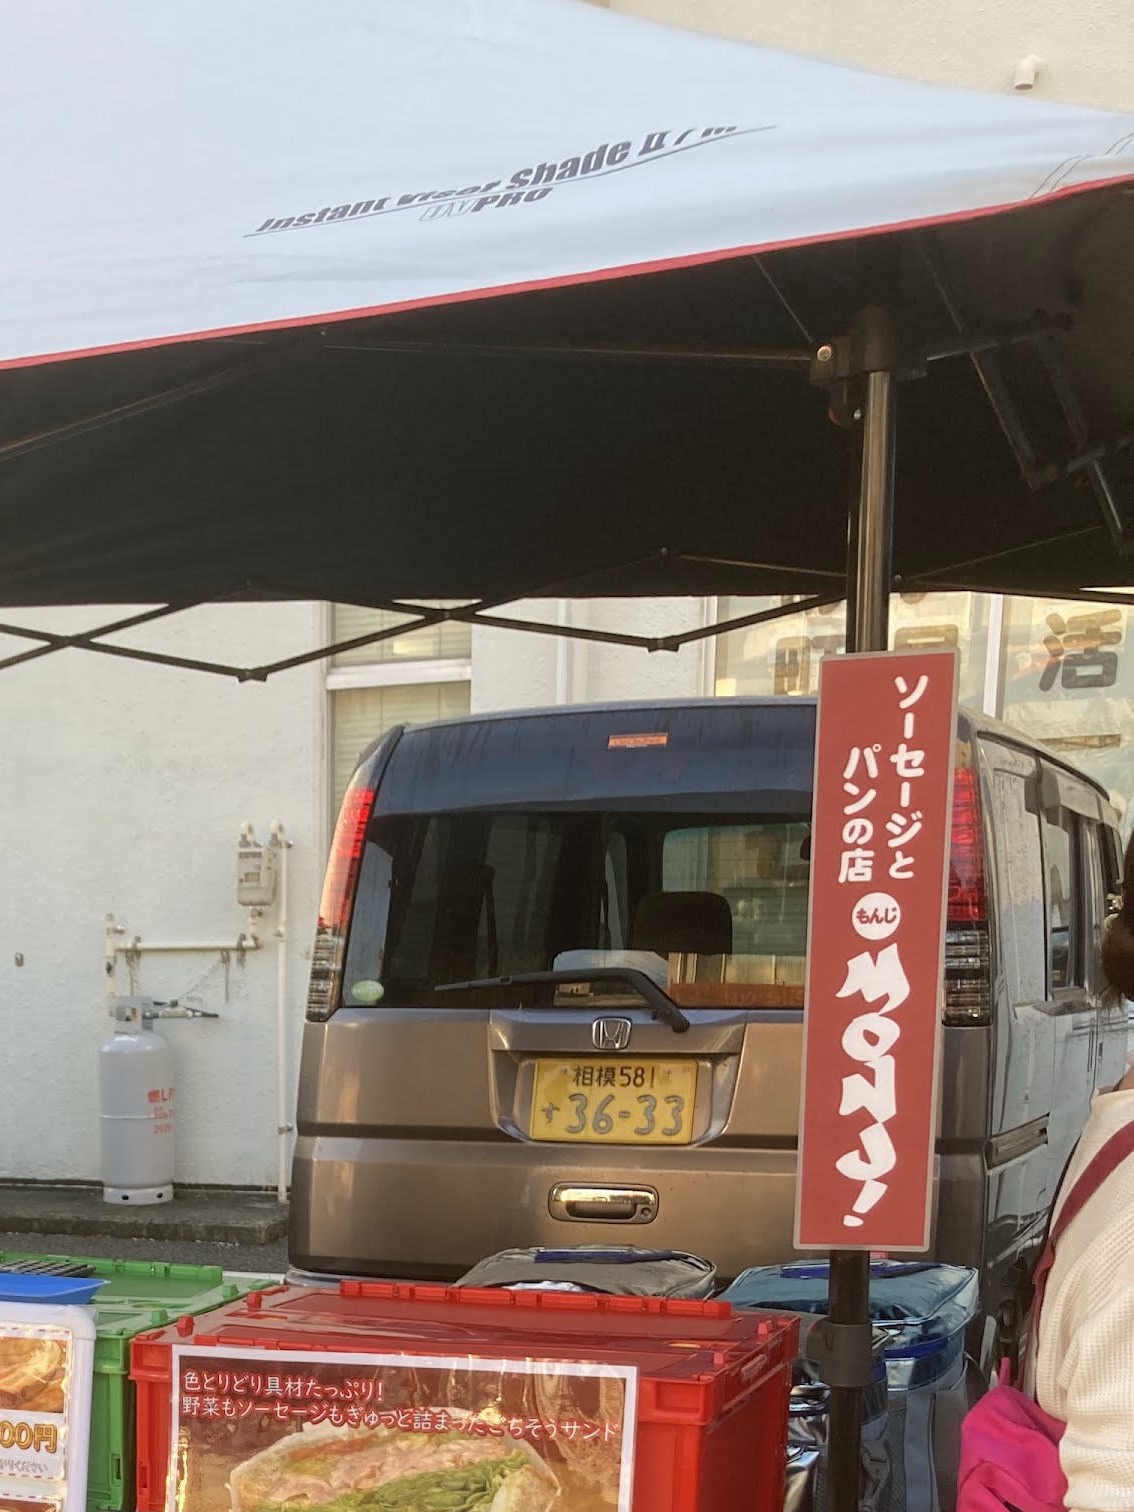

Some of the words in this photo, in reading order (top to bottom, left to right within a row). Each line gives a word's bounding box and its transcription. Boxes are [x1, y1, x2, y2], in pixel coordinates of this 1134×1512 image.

[505, 140, 631, 190] Shade
[1038, 608, 1123, 691] 活
[884, 673, 929, 880] ソーセージと
[837, 743, 882, 884] パンの店
[855, 907, 898, 926] もんじ
[540, 1101, 561, 1124] す
[564, 1092, 685, 1136] 36-33
[181, 1396, 620, 1443] 野菜もソーセージもぎゅっと詰まったごちそうサンド
